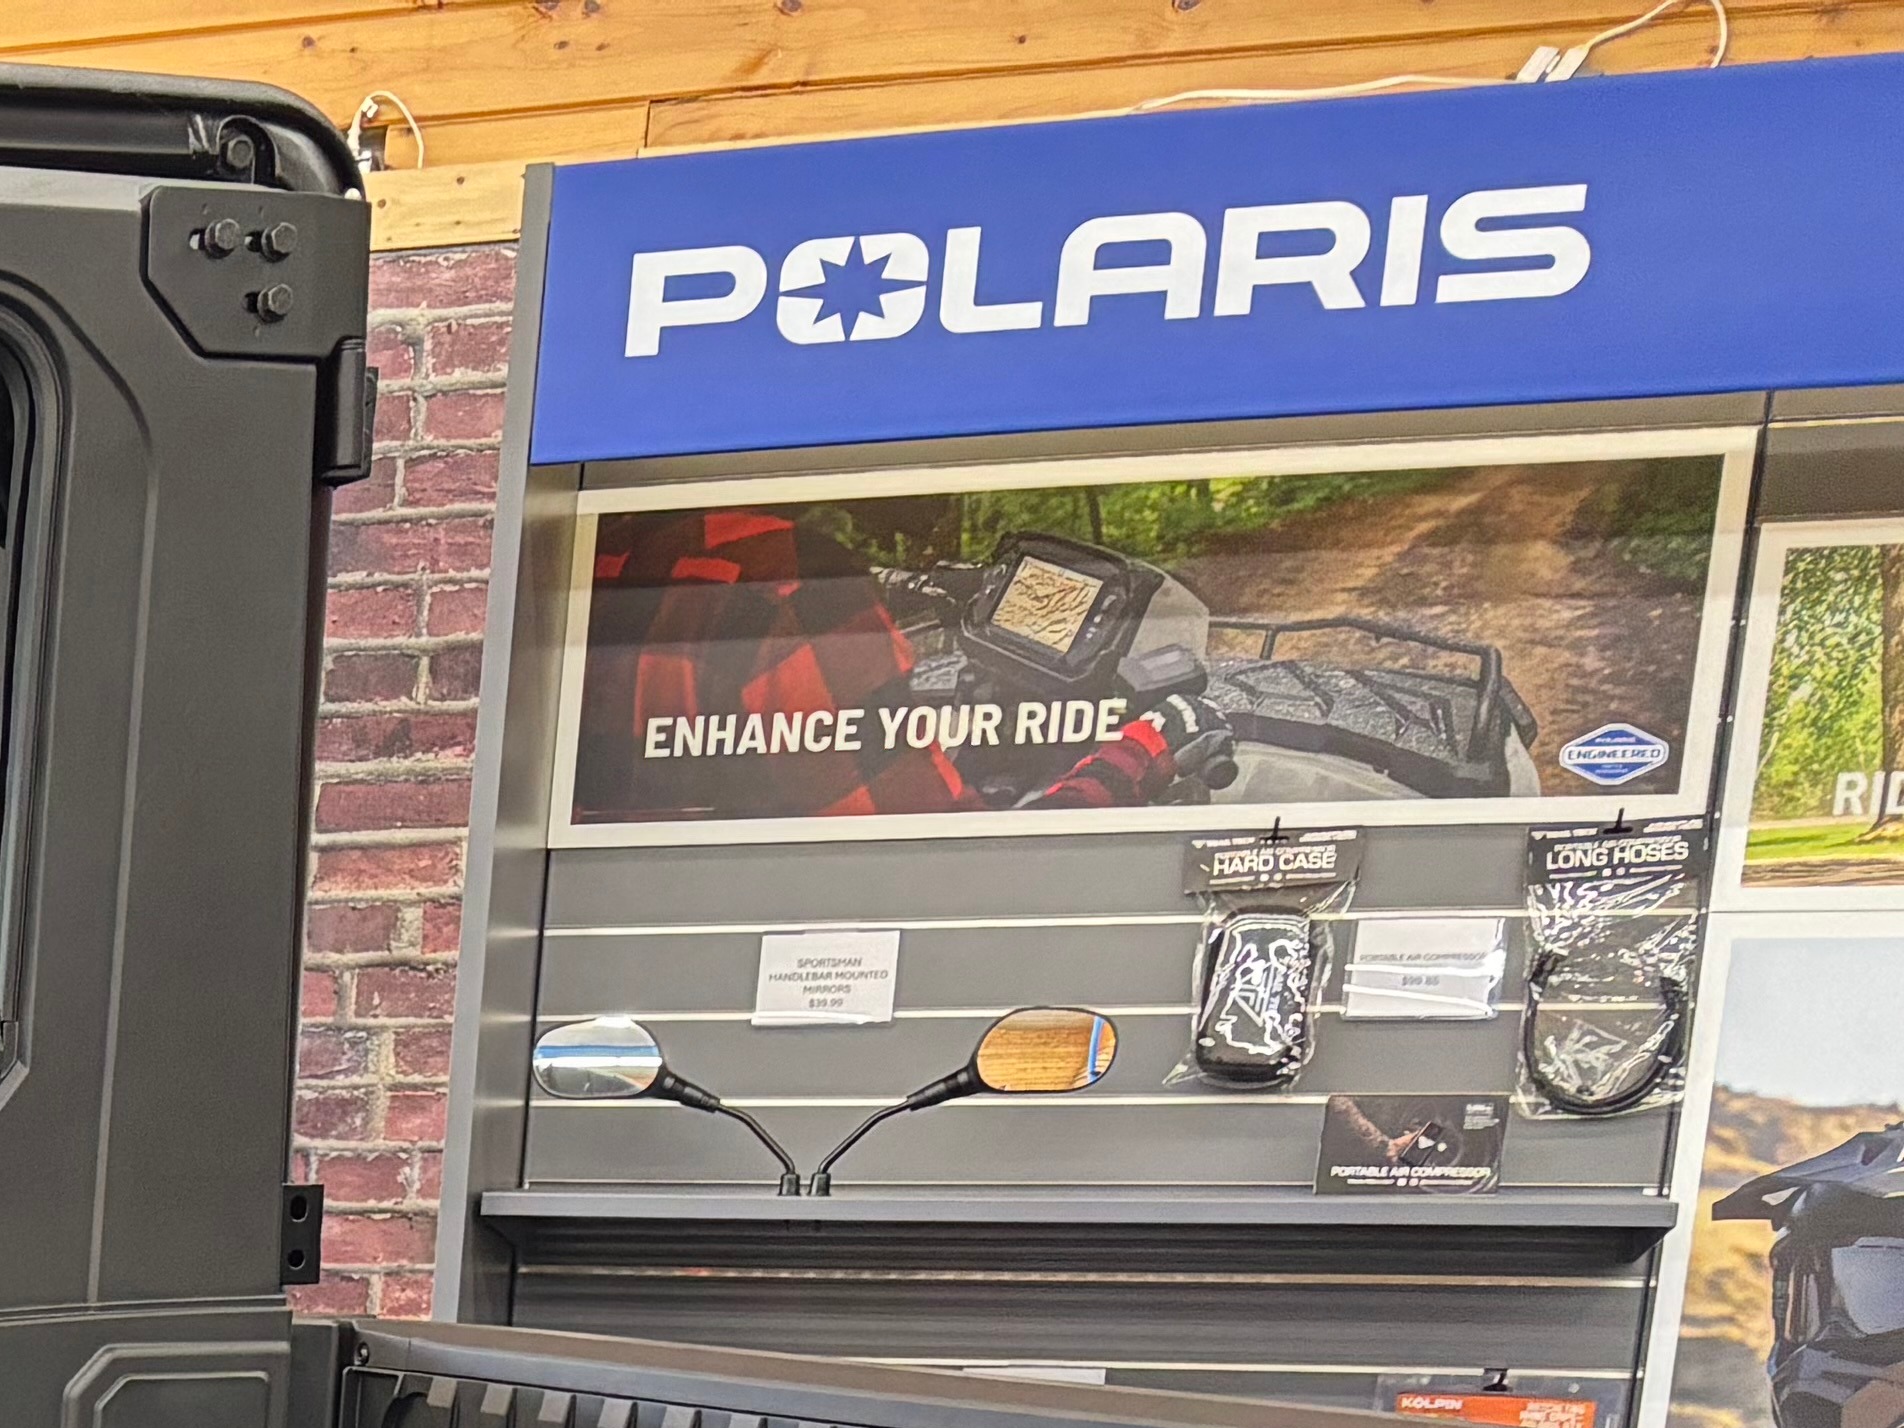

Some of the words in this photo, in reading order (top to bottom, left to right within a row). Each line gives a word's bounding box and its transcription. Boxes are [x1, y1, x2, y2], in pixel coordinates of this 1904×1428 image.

[624, 183, 1590, 358] POLARIS
[644, 708, 865, 759] ENHANCE
[880, 703, 1003, 752] YOUR
[1014, 697, 1128, 746] RIDE
[1213, 855, 1275, 876] HARD
[1278, 852, 1337, 871] CASE
[1546, 849, 1608, 870] LONG
[1612, 841, 1689, 864] HOSES
[797, 957, 863, 969] SPORTSMAN
[768, 971, 833, 982] HANDLEBAR
[834, 969, 889, 980] MOUNTED
[802, 984, 852, 995] MIRRORS
[1401, 1396, 1464, 1411] KOLPIN
